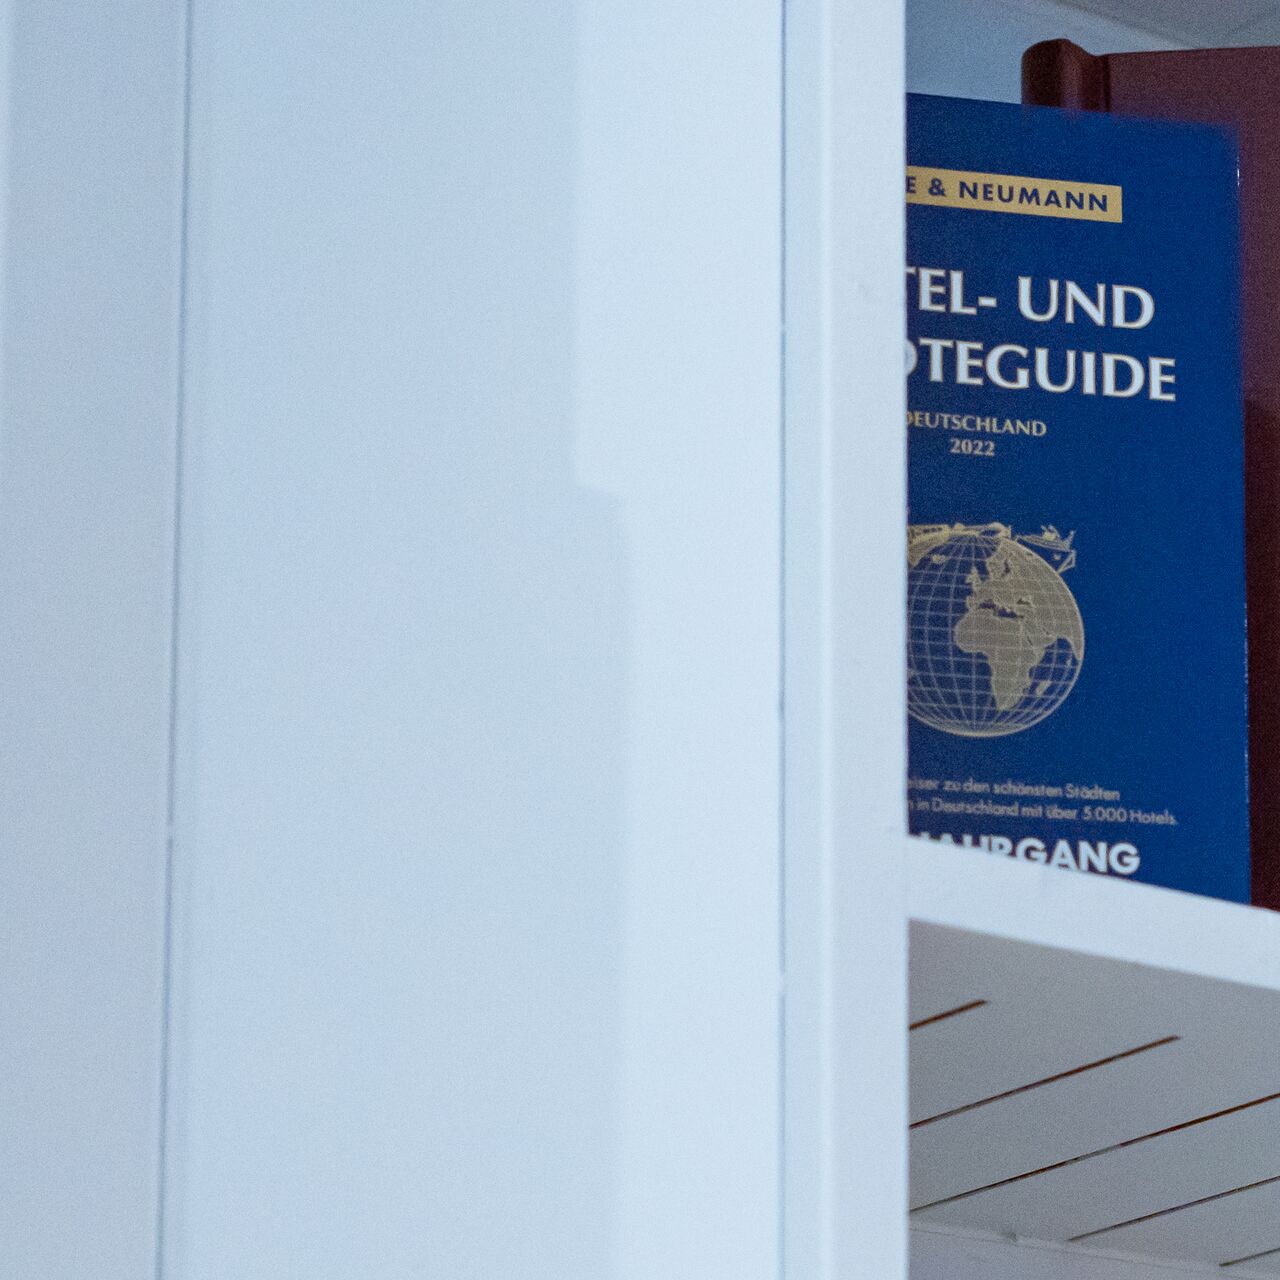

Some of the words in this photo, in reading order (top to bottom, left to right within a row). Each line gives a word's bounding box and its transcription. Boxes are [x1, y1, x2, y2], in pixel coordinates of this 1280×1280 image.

[928, 177, 946, 198] &
[959, 180, 1108, 213] NEUMANN
[1017, 275, 1155, 330] UND
[949, 437, 996, 457] 2022
[963, 777, 990, 793] den
[931, 797, 1019, 817] Deutschland
[1021, 803, 1042, 817] mit
